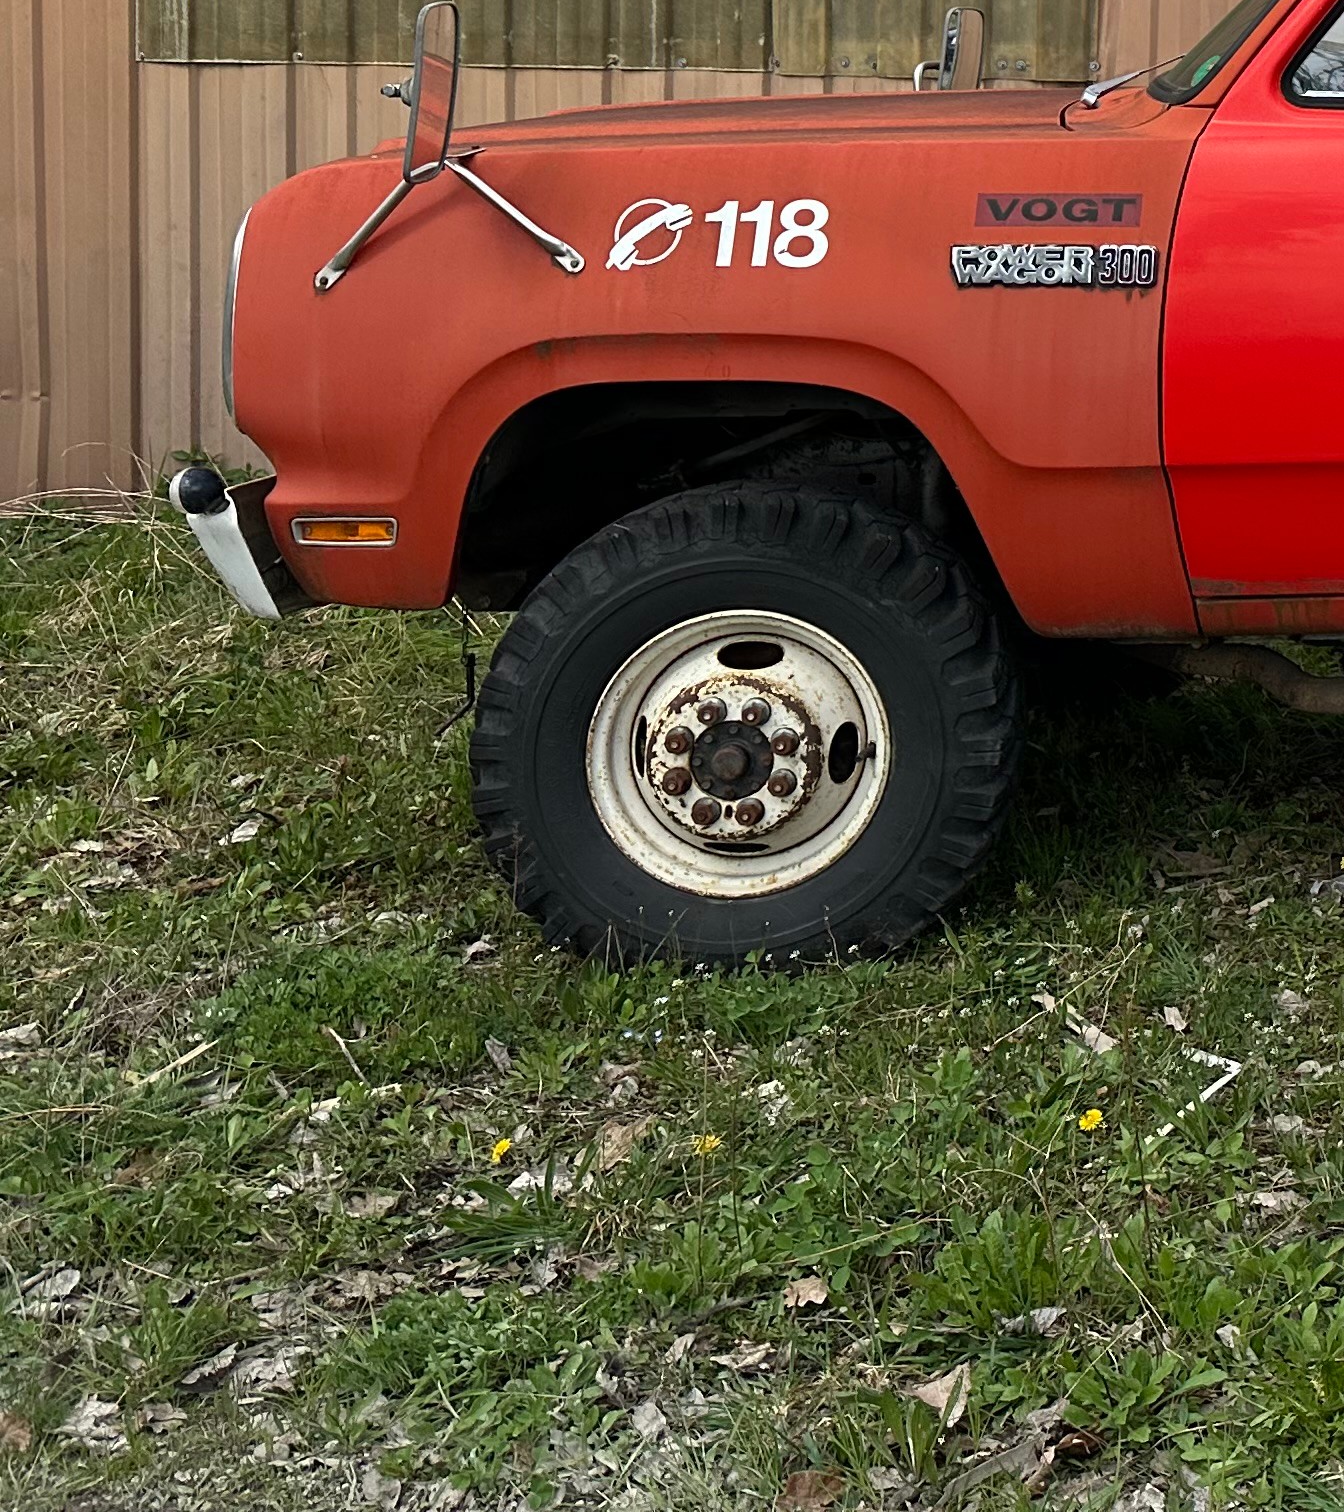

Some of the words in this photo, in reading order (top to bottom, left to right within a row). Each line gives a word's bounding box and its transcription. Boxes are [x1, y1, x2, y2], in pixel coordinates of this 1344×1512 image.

[985, 197, 1137, 222] VOGT
[704, 198, 829, 268] 118
[951, 244, 1095, 265] POWER
[1099, 244, 1157, 285] 300
[956, 261, 1093, 285] WAGON
